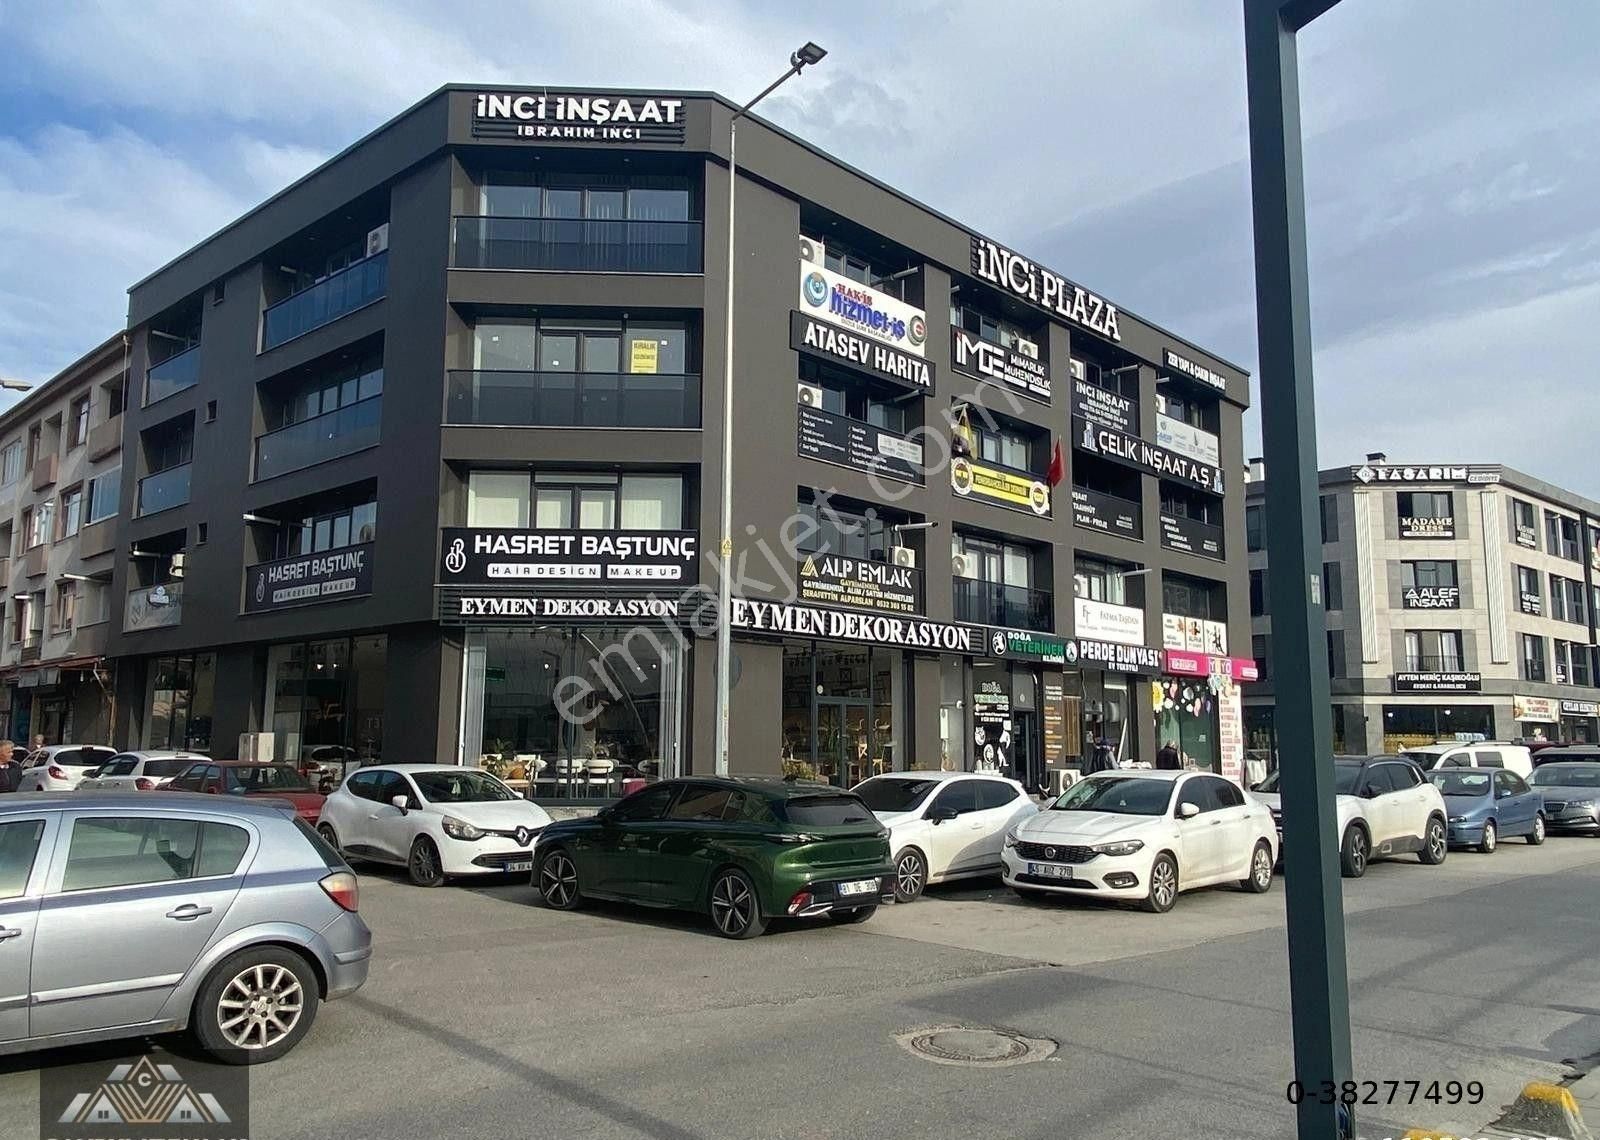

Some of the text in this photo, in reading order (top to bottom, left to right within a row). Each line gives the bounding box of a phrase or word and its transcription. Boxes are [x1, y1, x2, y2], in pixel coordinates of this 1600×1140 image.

[1041, 270, 1121, 342] PLAZA
[804, 321, 870, 365] ATASEV
[1099, 431, 1138, 462] ÇELİK
[1141, 443, 1188, 477] İNŞAAT
[1376, 467, 1467, 480] TASARIM
[1401, 517, 1453, 526] MADAME
[474, 535, 696, 560] HASRET BAŞTUNÇ
[268, 550, 365, 583] HASRET BAŞTUNÇ
[821, 557, 912, 589] ALP EMLAK
[1420, 588, 1458, 598] ALEF
[460, 598, 680, 617] EYMEN DEKORASYON
[730, 598, 971, 650] EYMEN DEKORASYON
[1007, 631, 1031, 641] DOĞA
[1008, 640, 1064, 656] VETERİNER
[1080, 640, 1115, 662] PERDE
